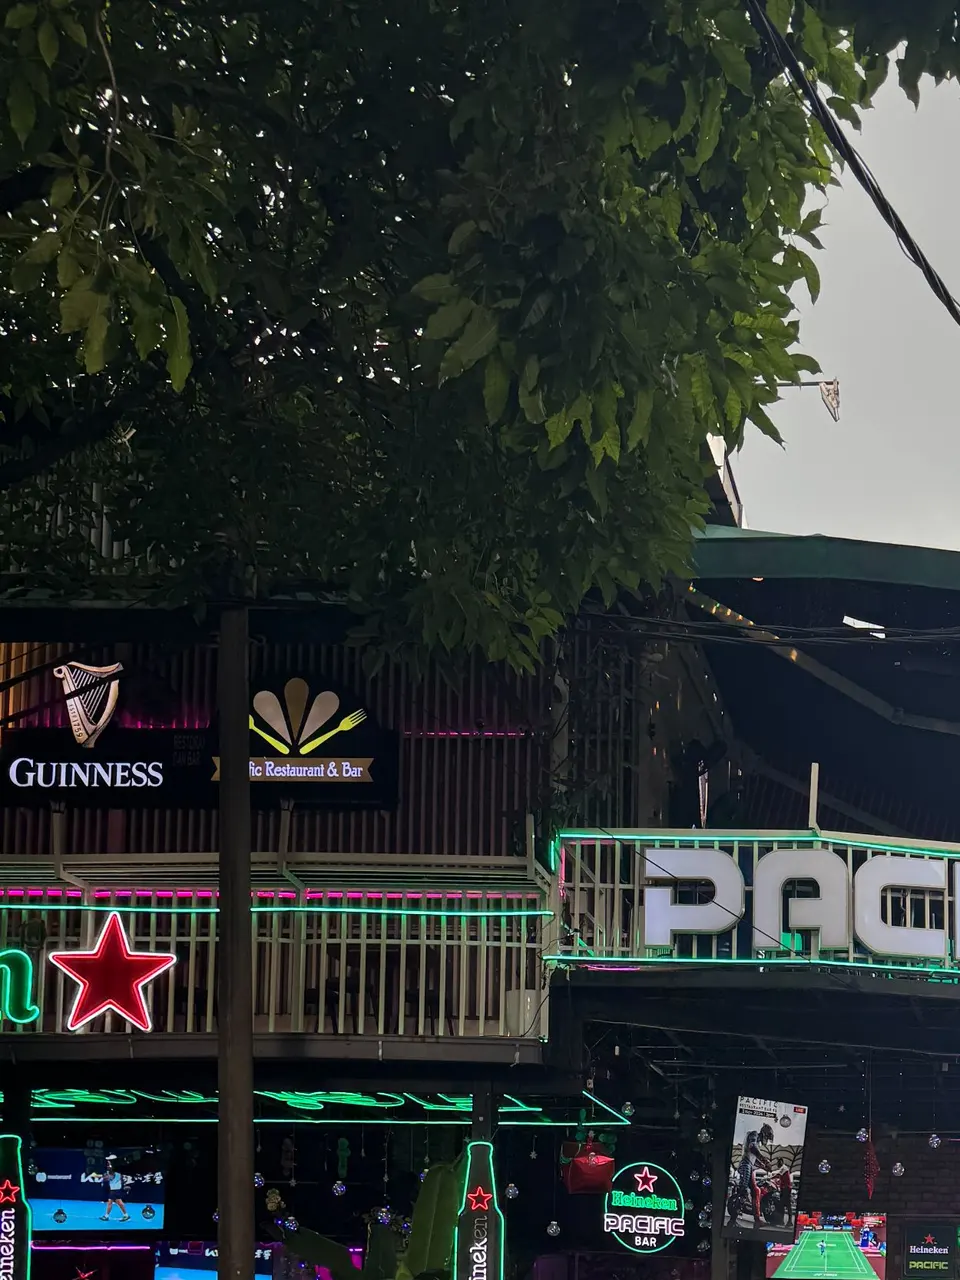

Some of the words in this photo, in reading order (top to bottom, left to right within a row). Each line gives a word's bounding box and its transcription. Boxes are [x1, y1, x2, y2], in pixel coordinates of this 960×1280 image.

[72, 719, 83, 738] 1759
[249, 761, 262, 778] fic
[265, 761, 325, 778] Restaurant
[327, 761, 339, 778] &
[342, 761, 363, 778] Bar
[612, 1191, 678, 1211] Heineken
[604, 1213, 685, 1236] PACIFIC
[635, 1236, 657, 1247] BAR
[909, 1245, 949, 1254] Heineken
[909, 1261, 949, 1270] PACIFIC
